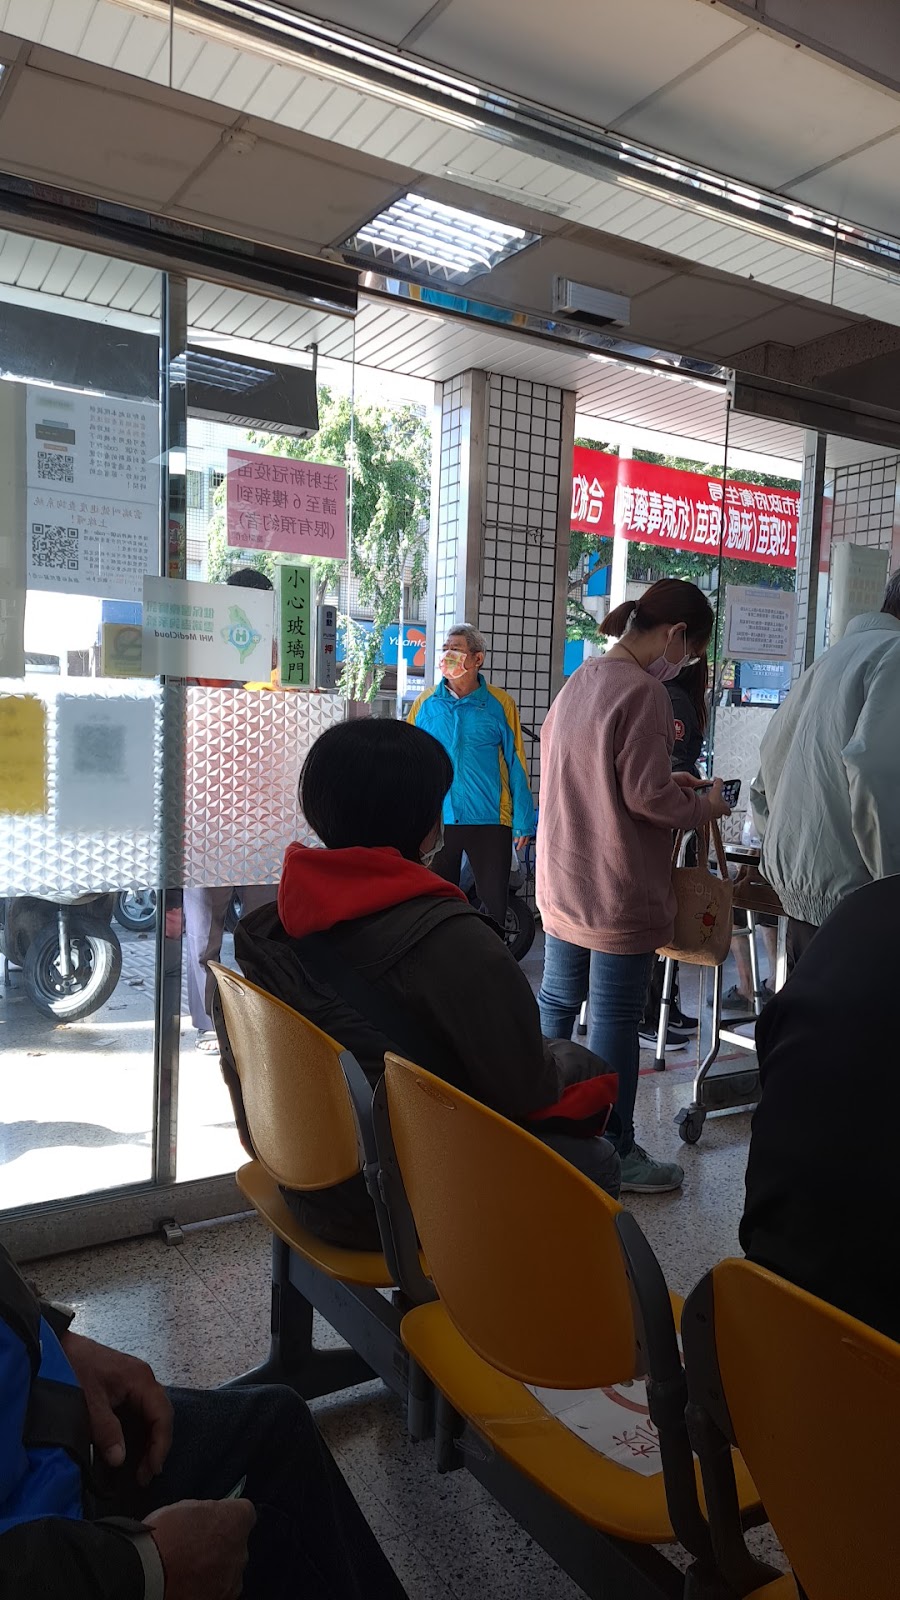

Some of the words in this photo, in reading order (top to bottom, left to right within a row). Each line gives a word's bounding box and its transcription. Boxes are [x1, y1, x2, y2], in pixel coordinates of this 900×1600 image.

[286, 568, 306, 683] 小心玻璃門
[324, 644, 334, 655] 押
